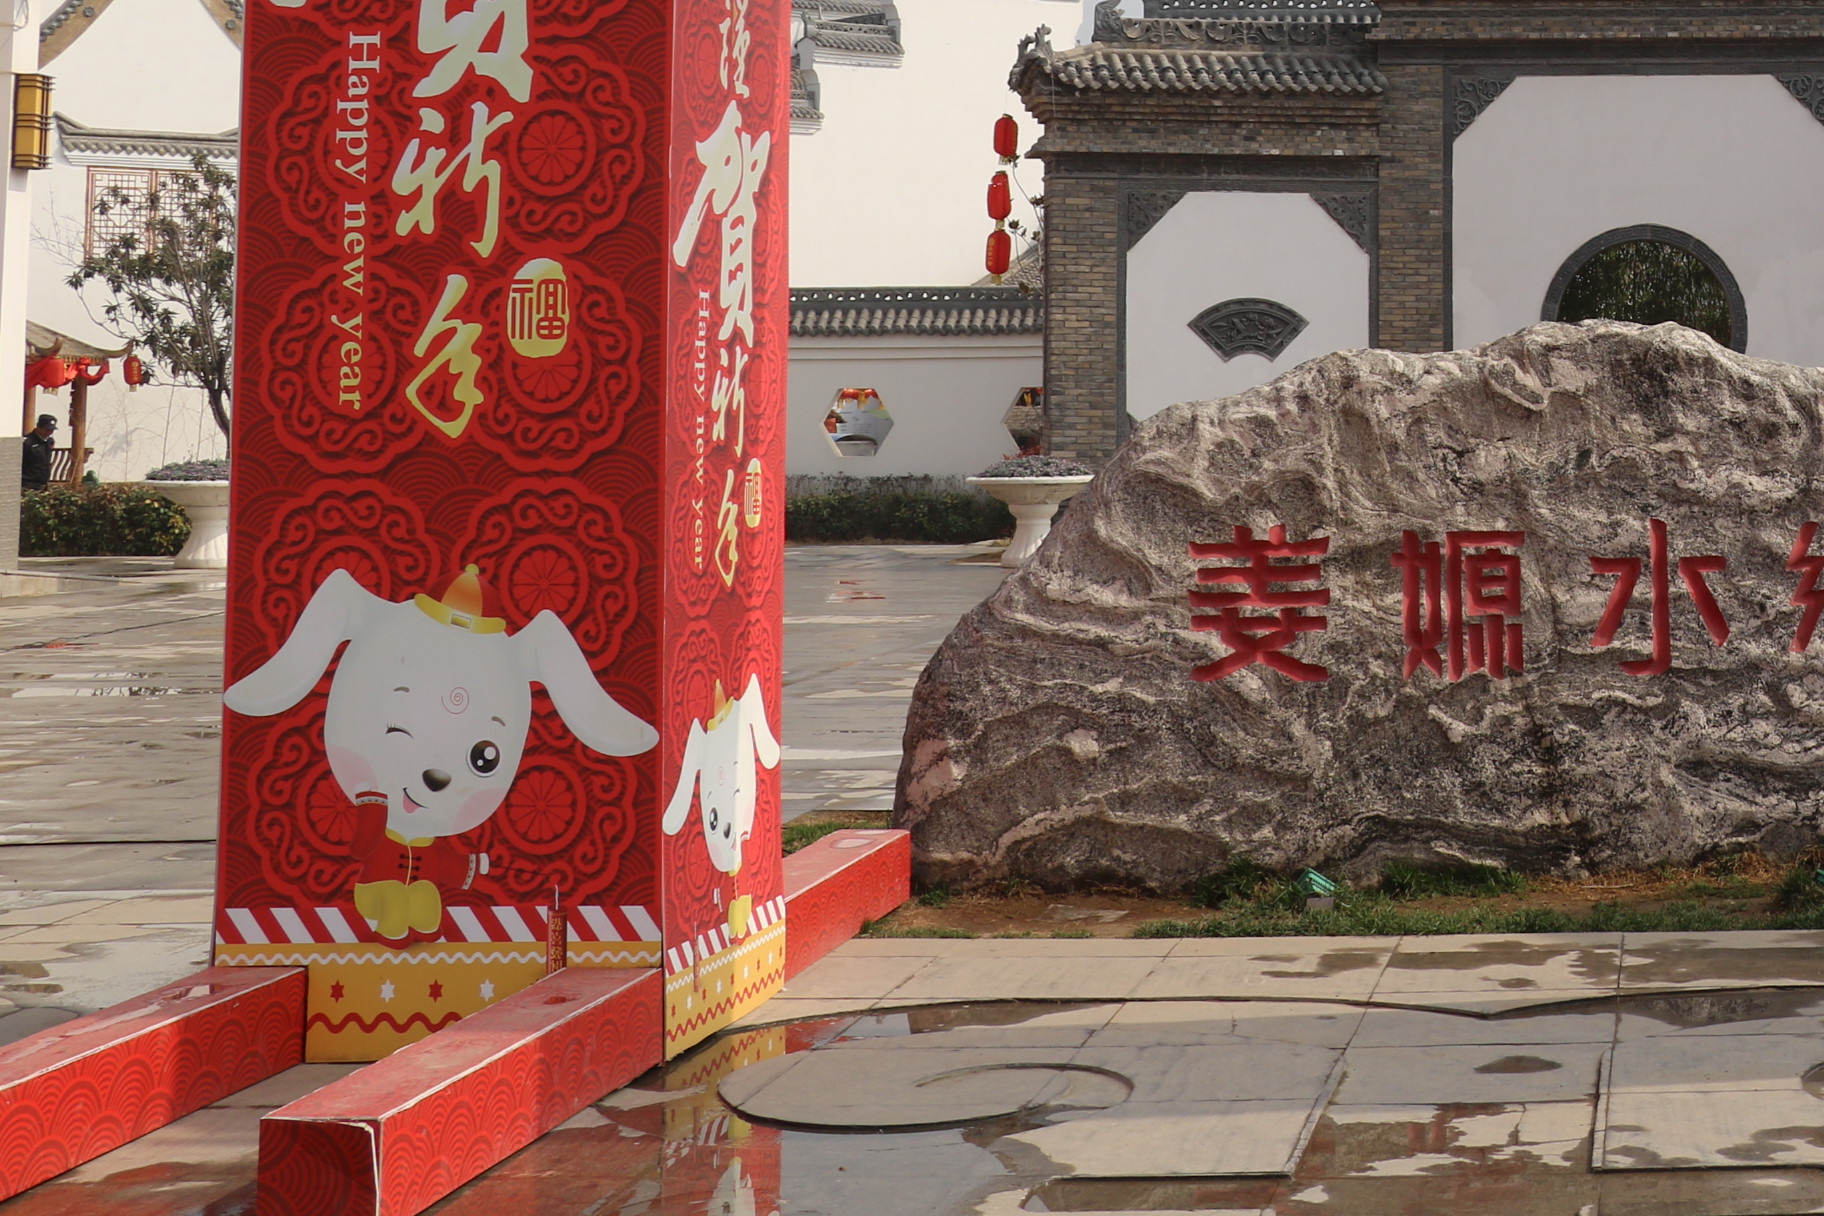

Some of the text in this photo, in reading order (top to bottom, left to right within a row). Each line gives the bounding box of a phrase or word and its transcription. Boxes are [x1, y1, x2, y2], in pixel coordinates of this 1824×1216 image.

[331, 30, 381, 411] Happy new year
[691, 288, 710, 569] Happy new year
